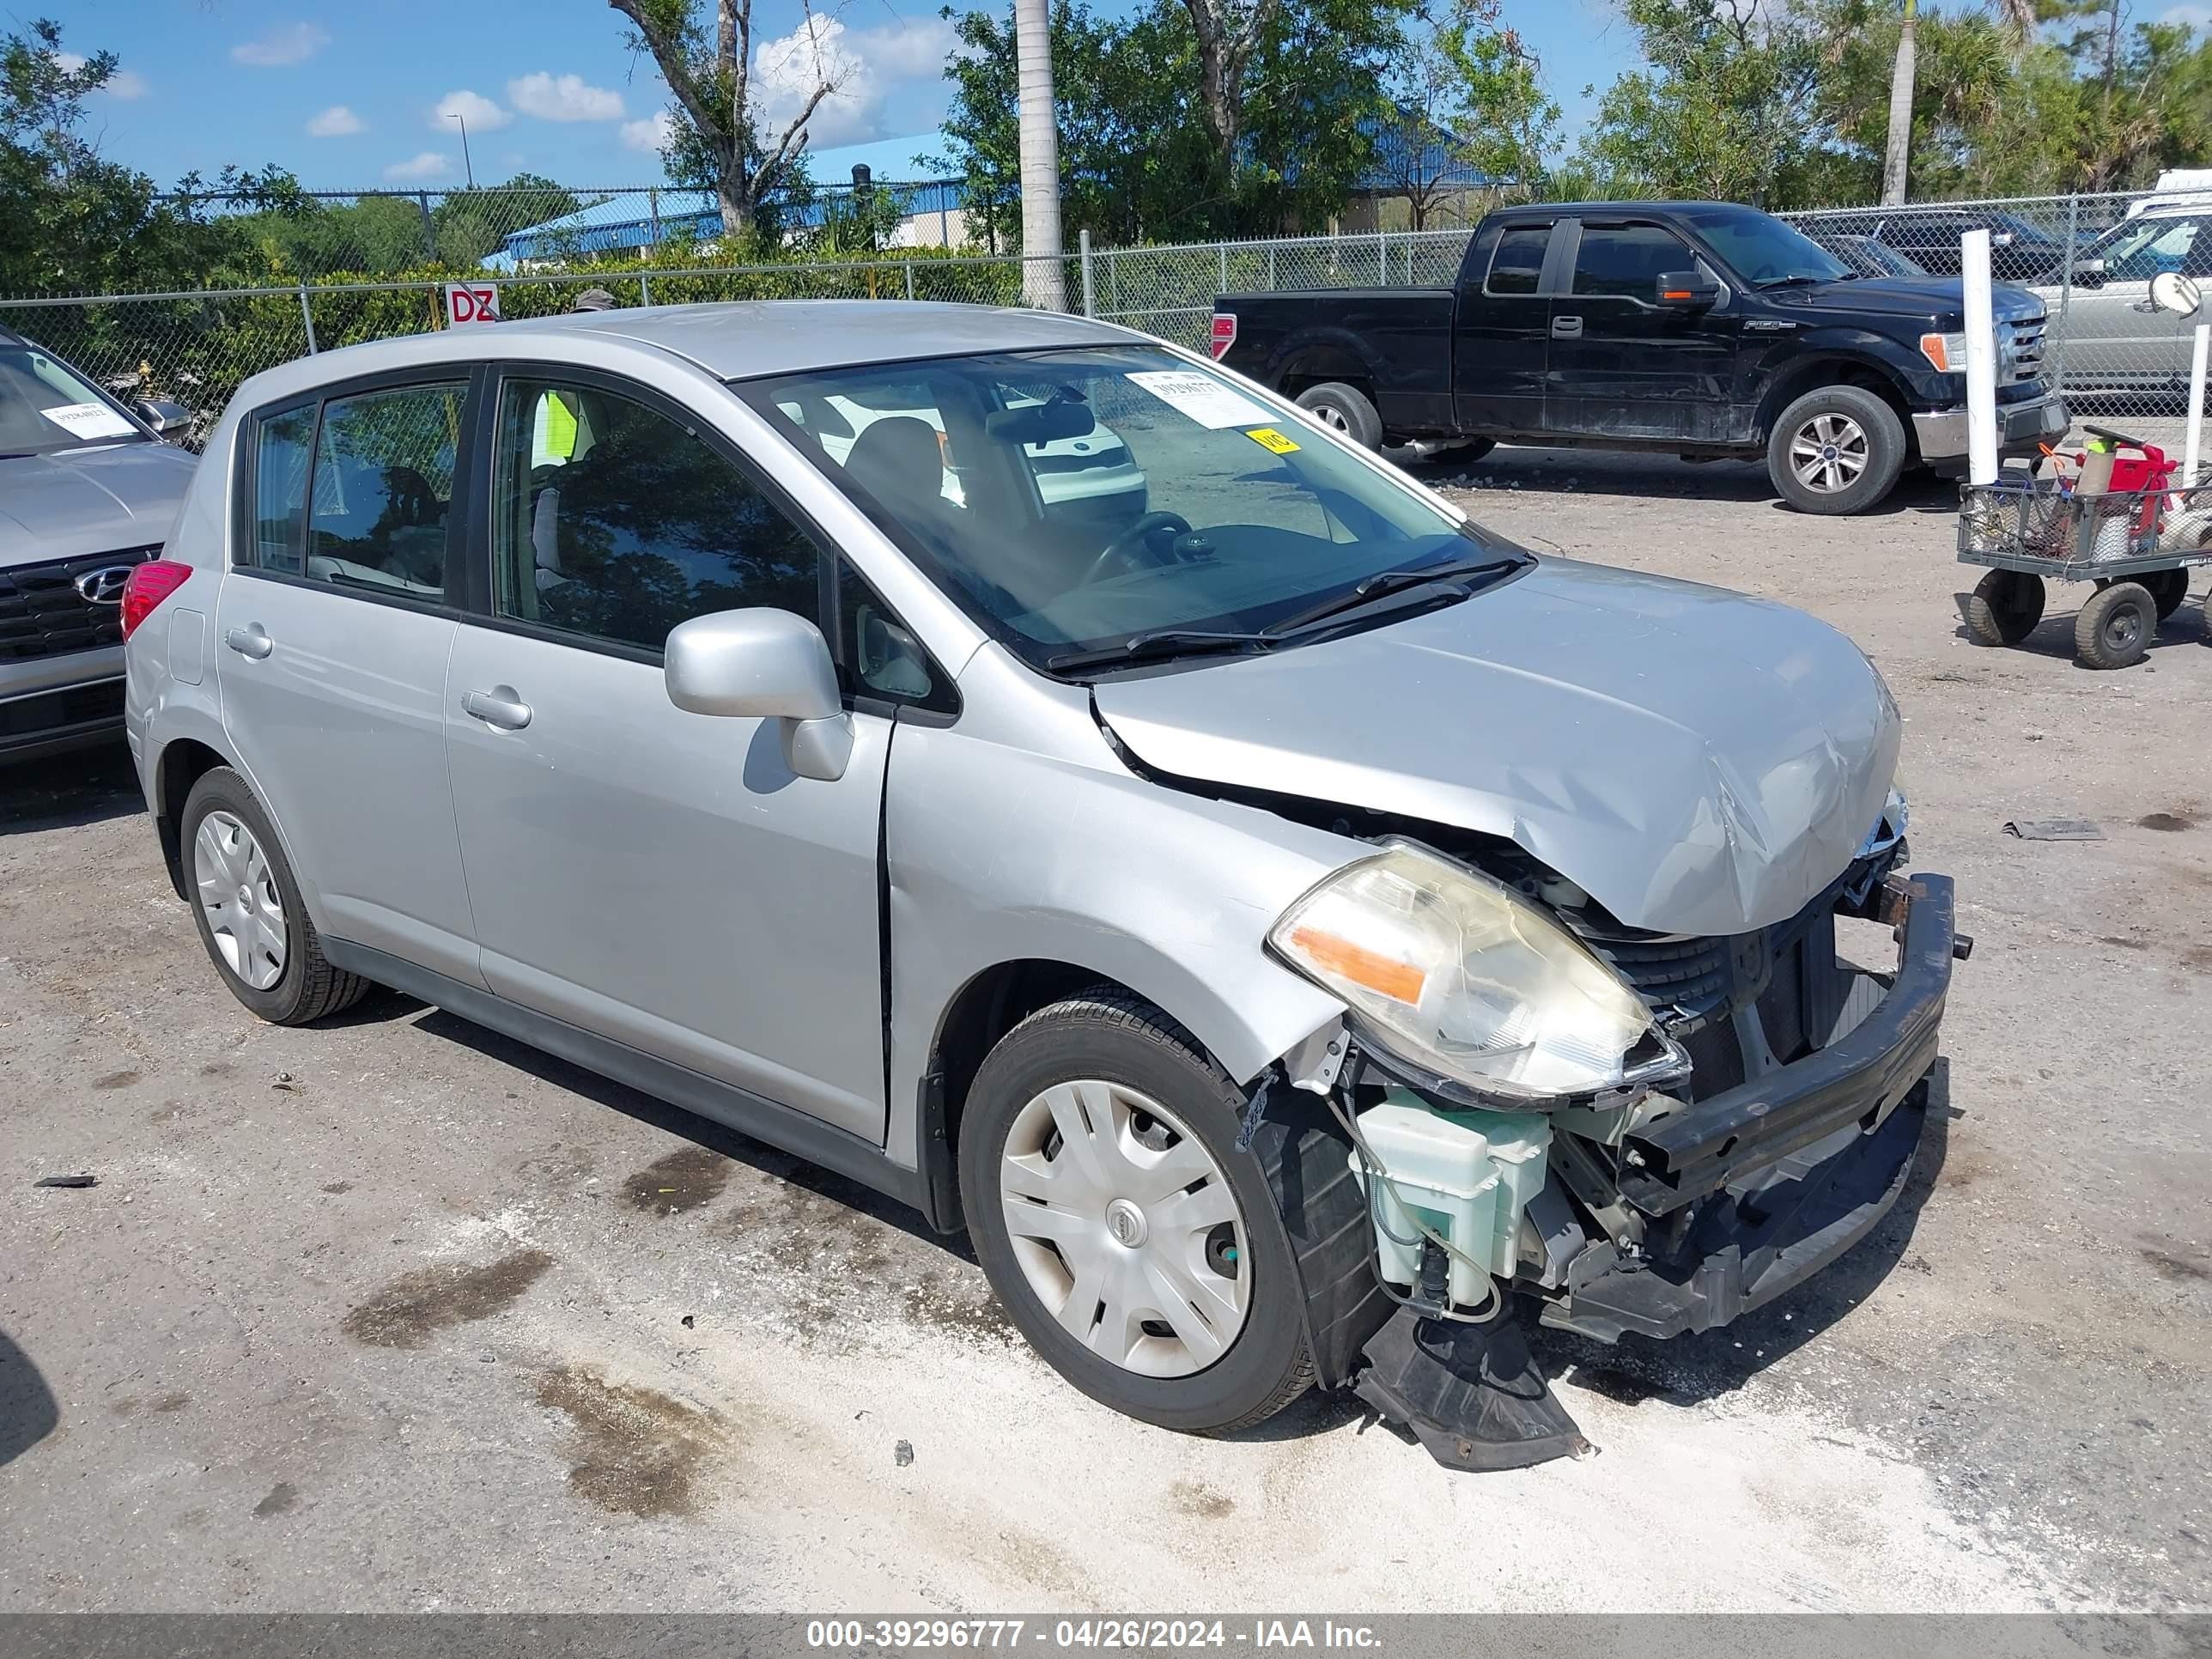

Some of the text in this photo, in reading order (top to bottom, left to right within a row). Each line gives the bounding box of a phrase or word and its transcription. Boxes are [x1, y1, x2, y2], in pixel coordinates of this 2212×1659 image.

[452, 290, 496, 322] DZ
[1153, 382, 1222, 395] 39296777
[1255, 434, 1291, 448] VIC
